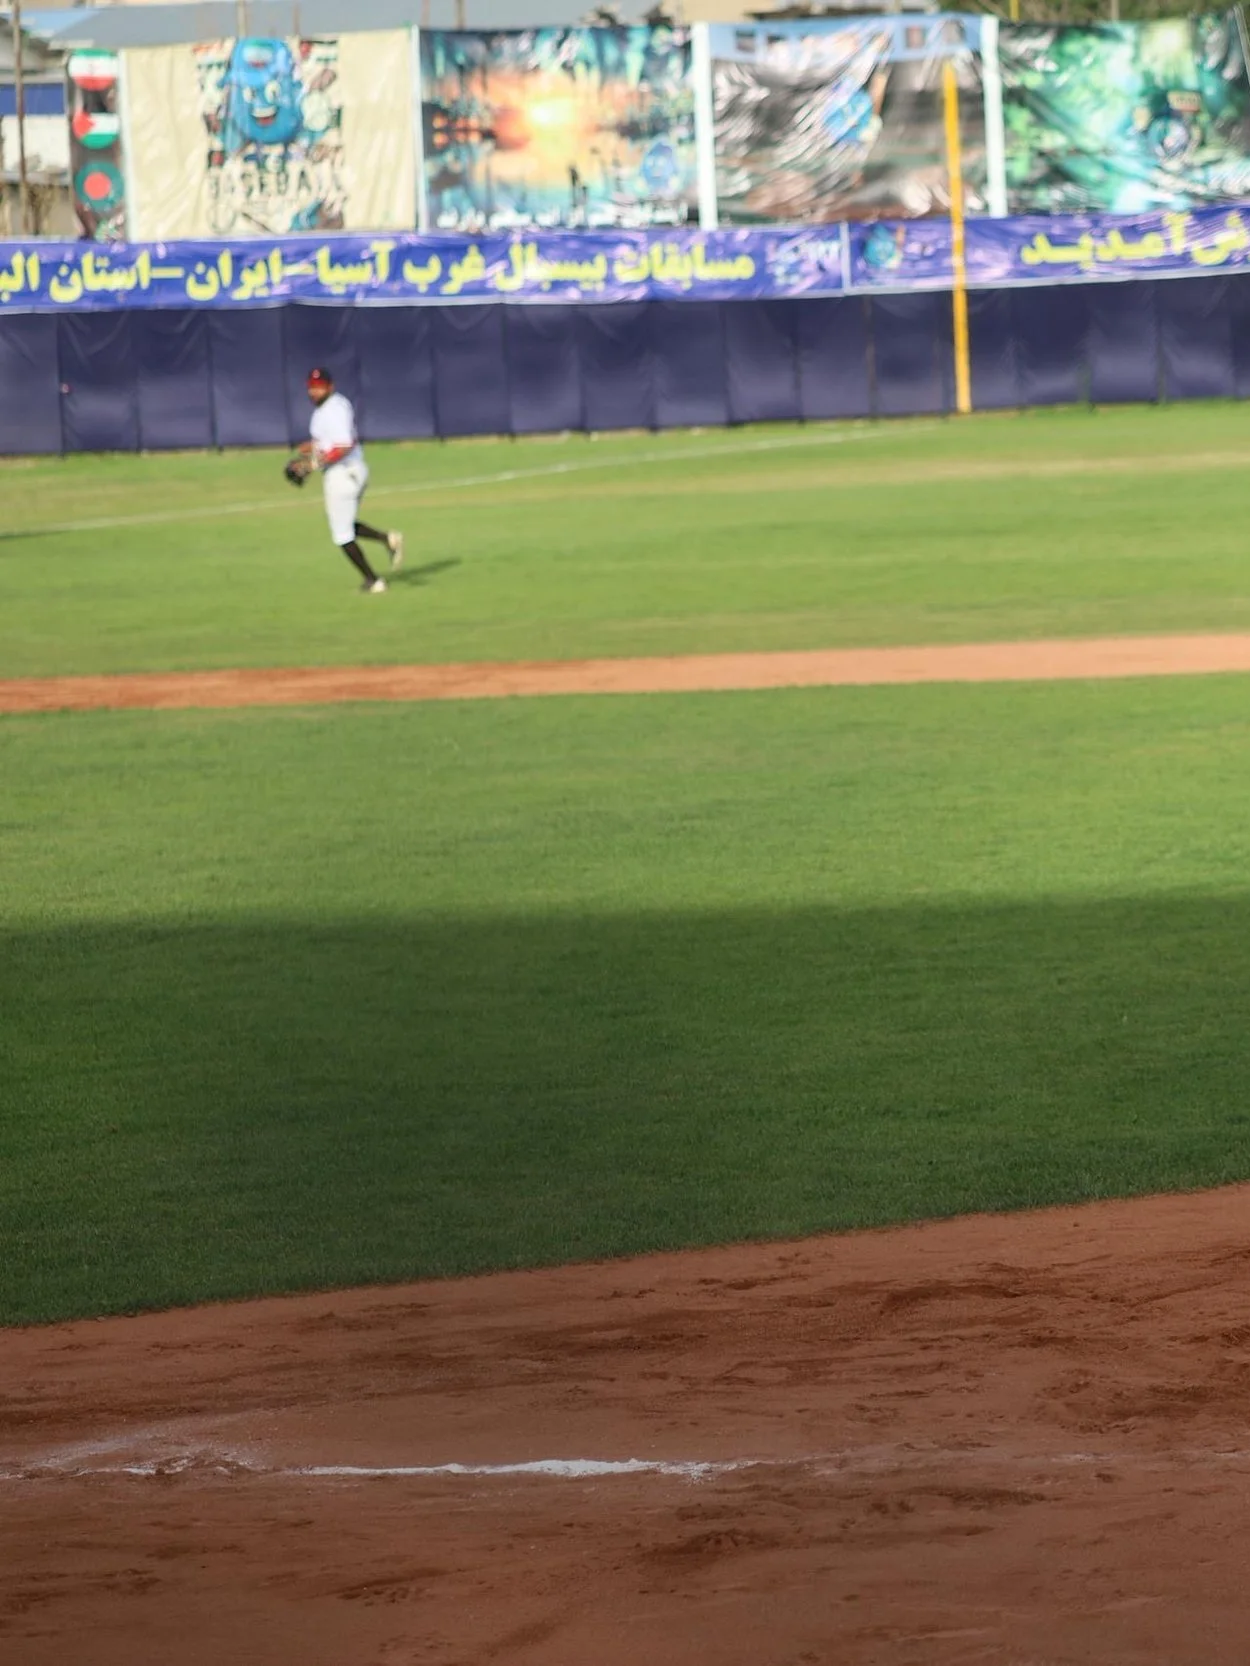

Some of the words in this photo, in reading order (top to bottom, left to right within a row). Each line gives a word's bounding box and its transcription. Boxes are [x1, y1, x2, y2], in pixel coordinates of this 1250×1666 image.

[1021, 211, 1191, 270] آمدید
[0, 252, 41, 304] الب
[403, 245, 486, 294] غرب
[494, 242, 608, 291] بیسبال
[614, 242, 756, 289] مسابقات
